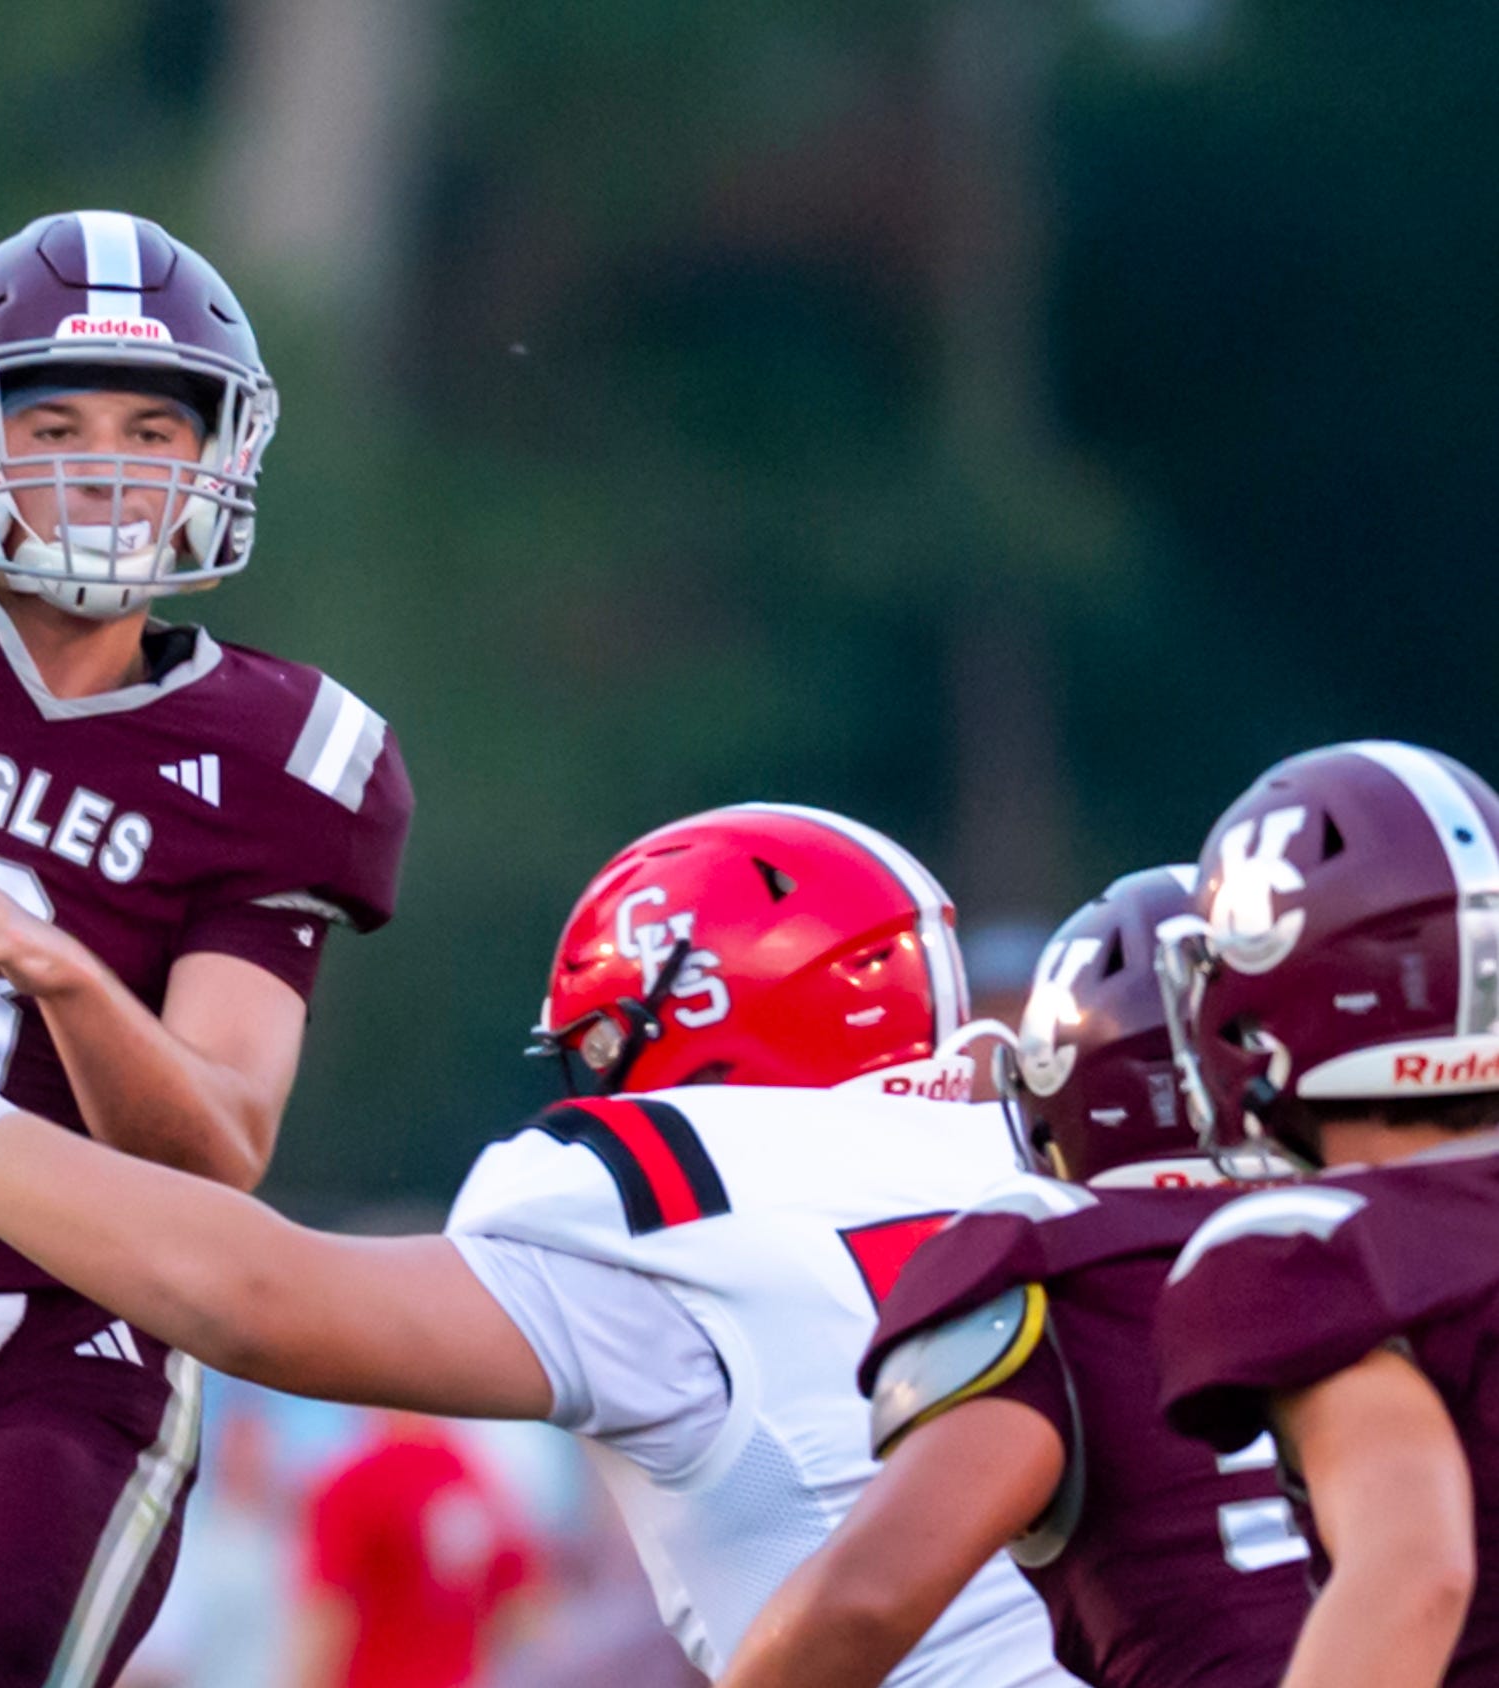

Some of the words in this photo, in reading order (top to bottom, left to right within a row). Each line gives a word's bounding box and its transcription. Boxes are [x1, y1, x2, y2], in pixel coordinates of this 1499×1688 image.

[70, 319, 160, 339] Riddell
[1393, 1051, 1499, 1085] Ridd
[882, 1068, 973, 1103] Ridd
